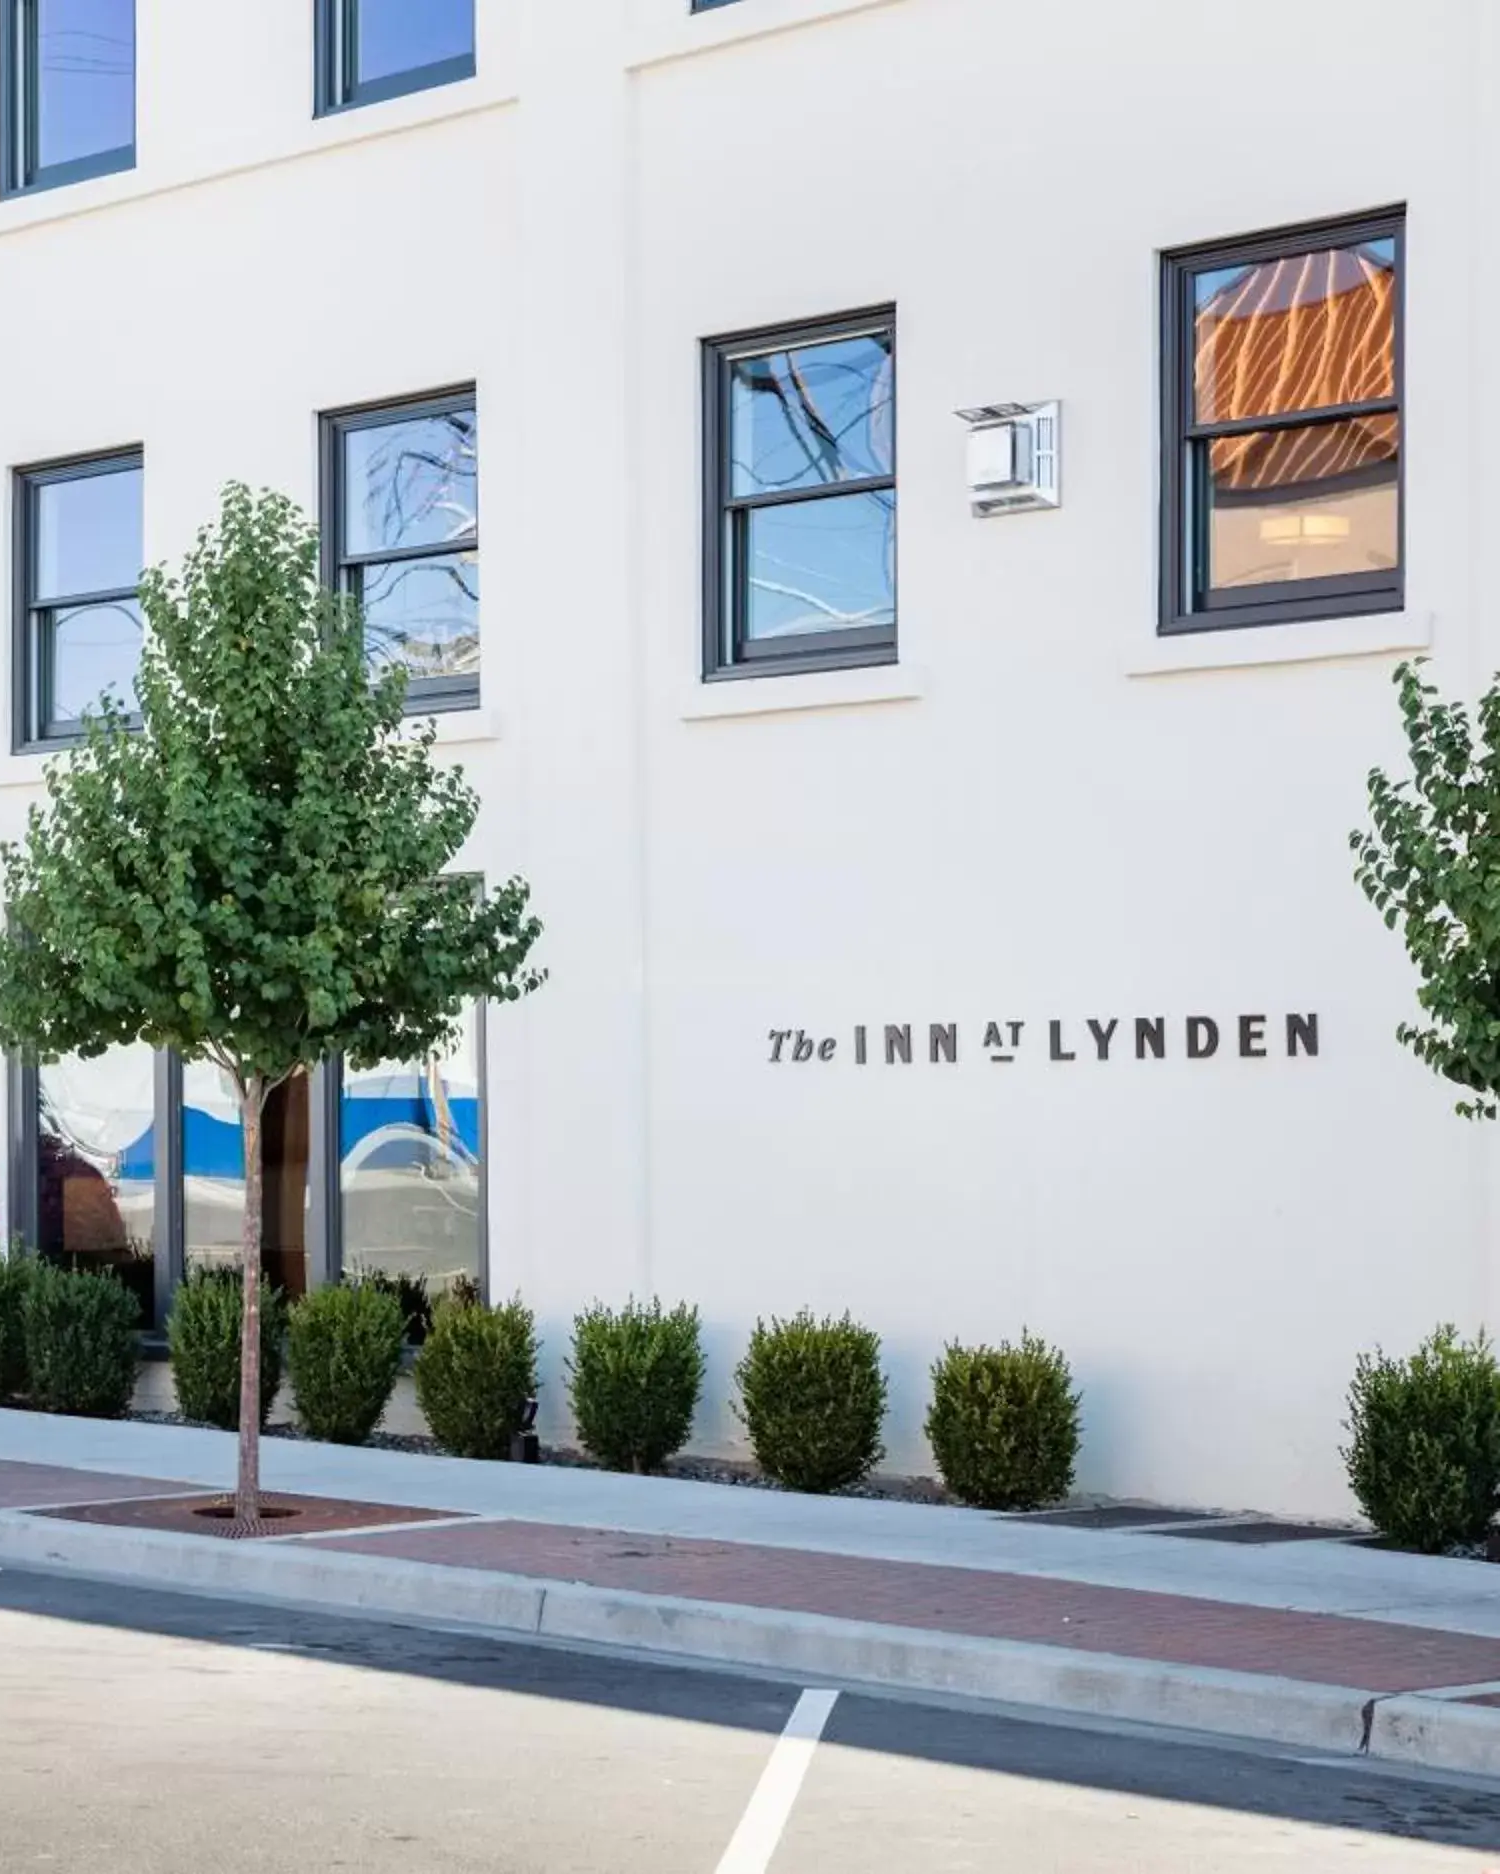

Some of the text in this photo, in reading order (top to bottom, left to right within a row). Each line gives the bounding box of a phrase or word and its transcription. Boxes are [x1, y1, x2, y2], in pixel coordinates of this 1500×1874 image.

[767, 1012, 1319, 1065] The INN AT LYNDEN
